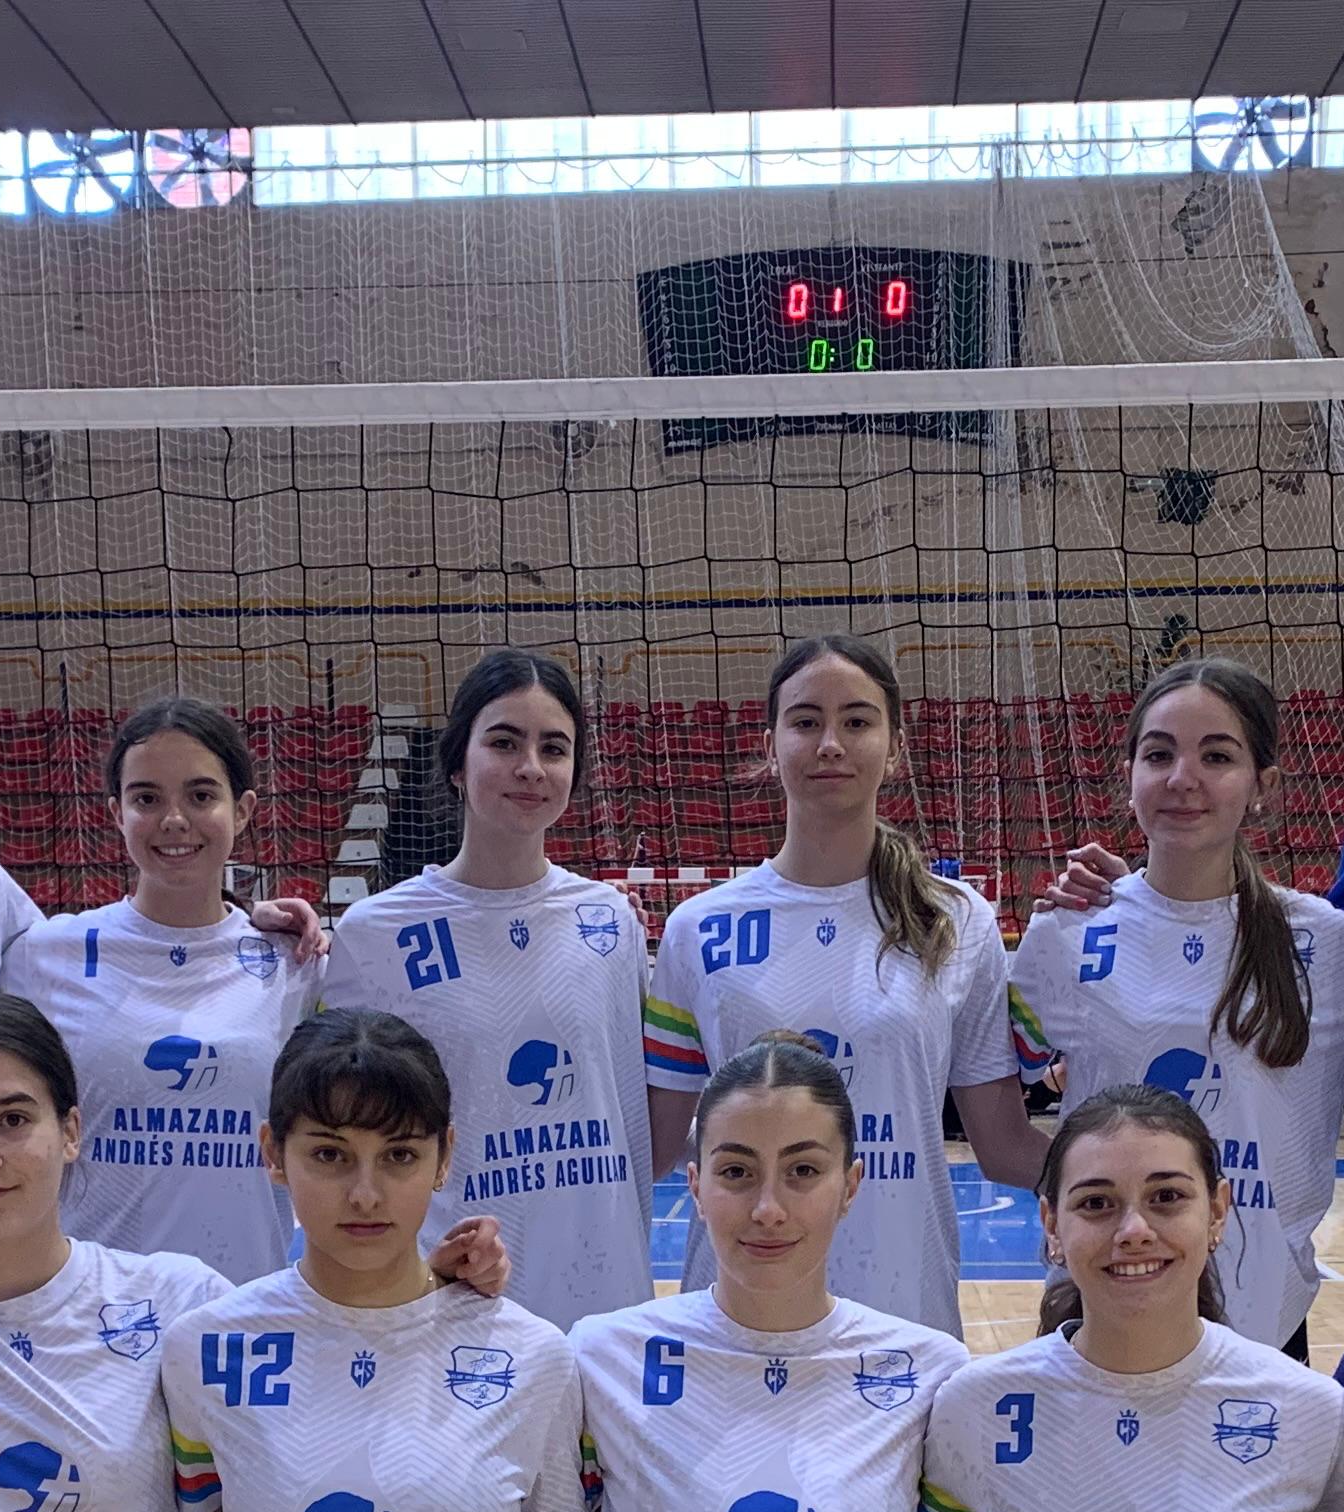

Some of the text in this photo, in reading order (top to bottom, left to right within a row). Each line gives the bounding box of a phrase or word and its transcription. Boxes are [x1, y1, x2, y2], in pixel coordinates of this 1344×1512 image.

[788, 284, 808, 319] 0
[833, 287, 843, 313] 1
[886, 281, 906, 316] 0
[84, 927, 99, 978] 1
[397, 917, 461, 990] 21
[699, 909, 771, 975] 20
[1079, 924, 1118, 984] 5
[113, 1107, 252, 1135] ALMAZARA
[483, 1117, 612, 1162] ALMAZARA
[91, 1135, 175, 1166] ANDRÉS
[463, 1153, 628, 1202] ANDRÉS AGUILAR
[201, 1331, 295, 1407] 42
[642, 1335, 685, 1406] 6
[995, 1393, 1036, 1464] 3
